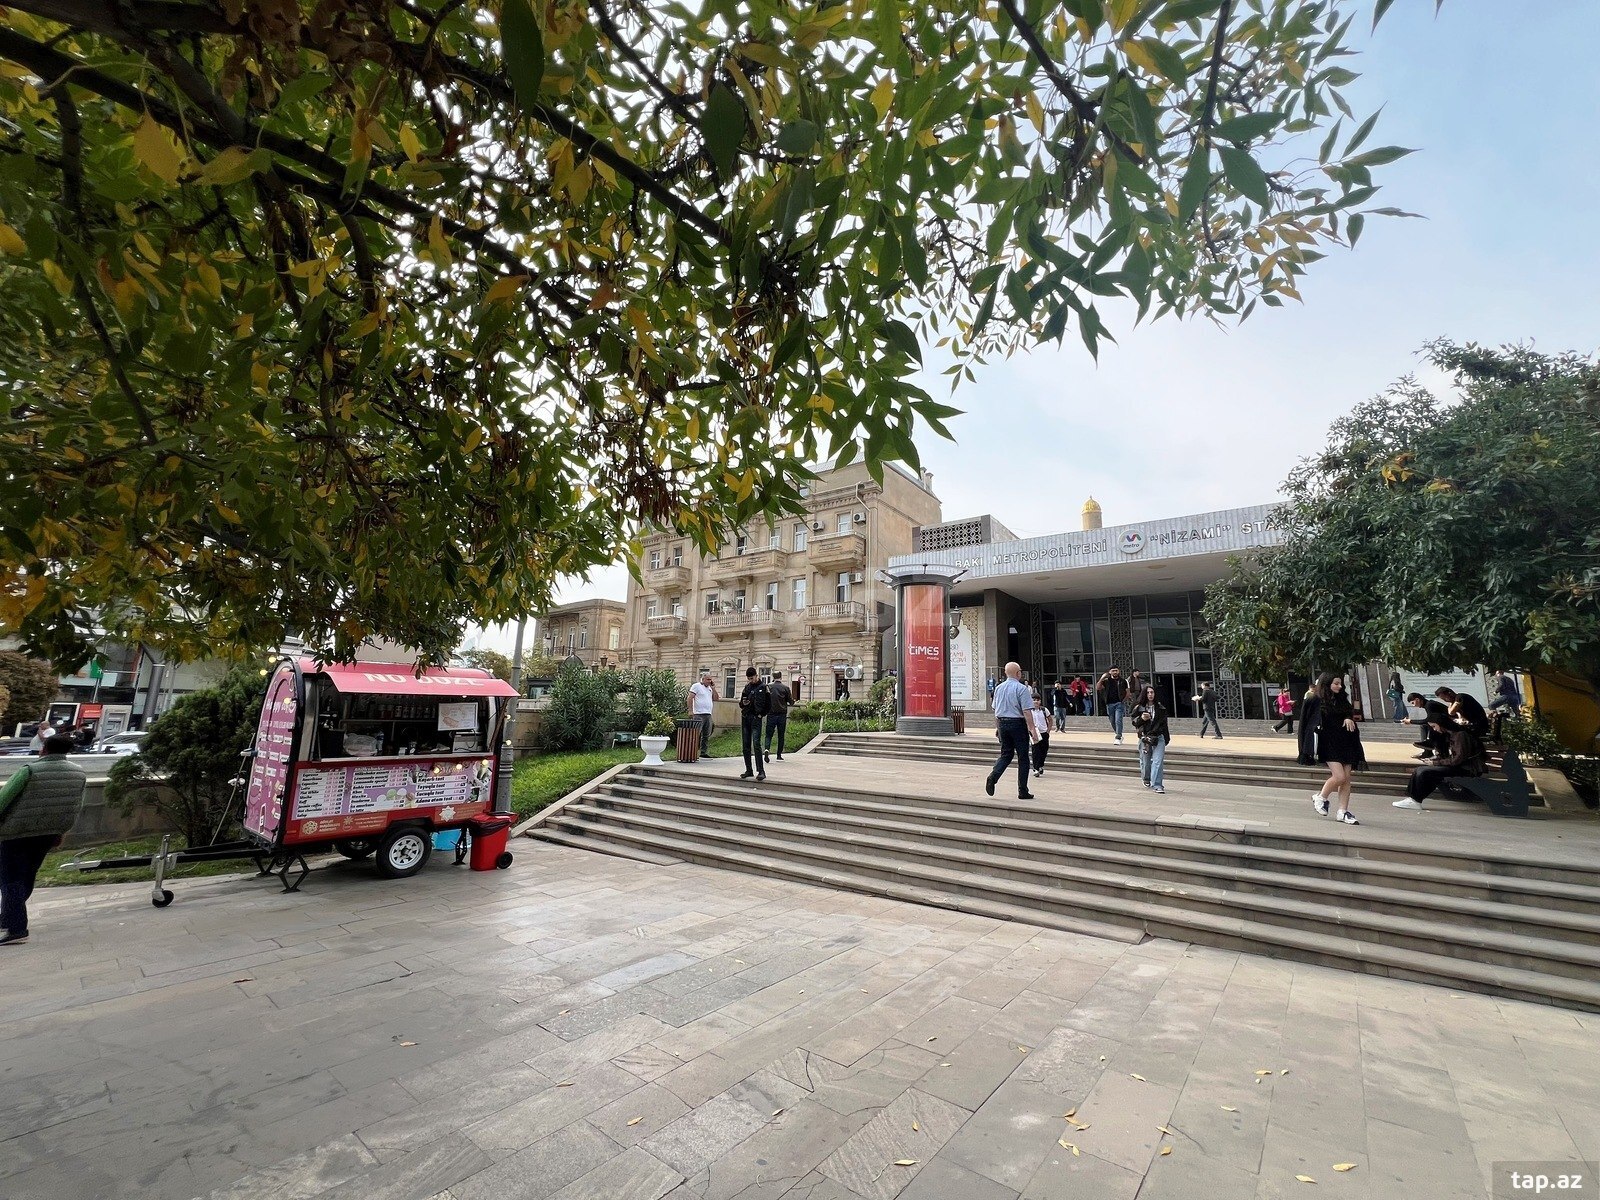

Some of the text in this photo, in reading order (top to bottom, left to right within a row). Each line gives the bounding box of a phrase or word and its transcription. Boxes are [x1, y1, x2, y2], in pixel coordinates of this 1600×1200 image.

[955, 557, 983, 568] BAKI
[993, 539, 1107, 565] METROPOLİTENİ
[364, 673, 407, 683] NO
